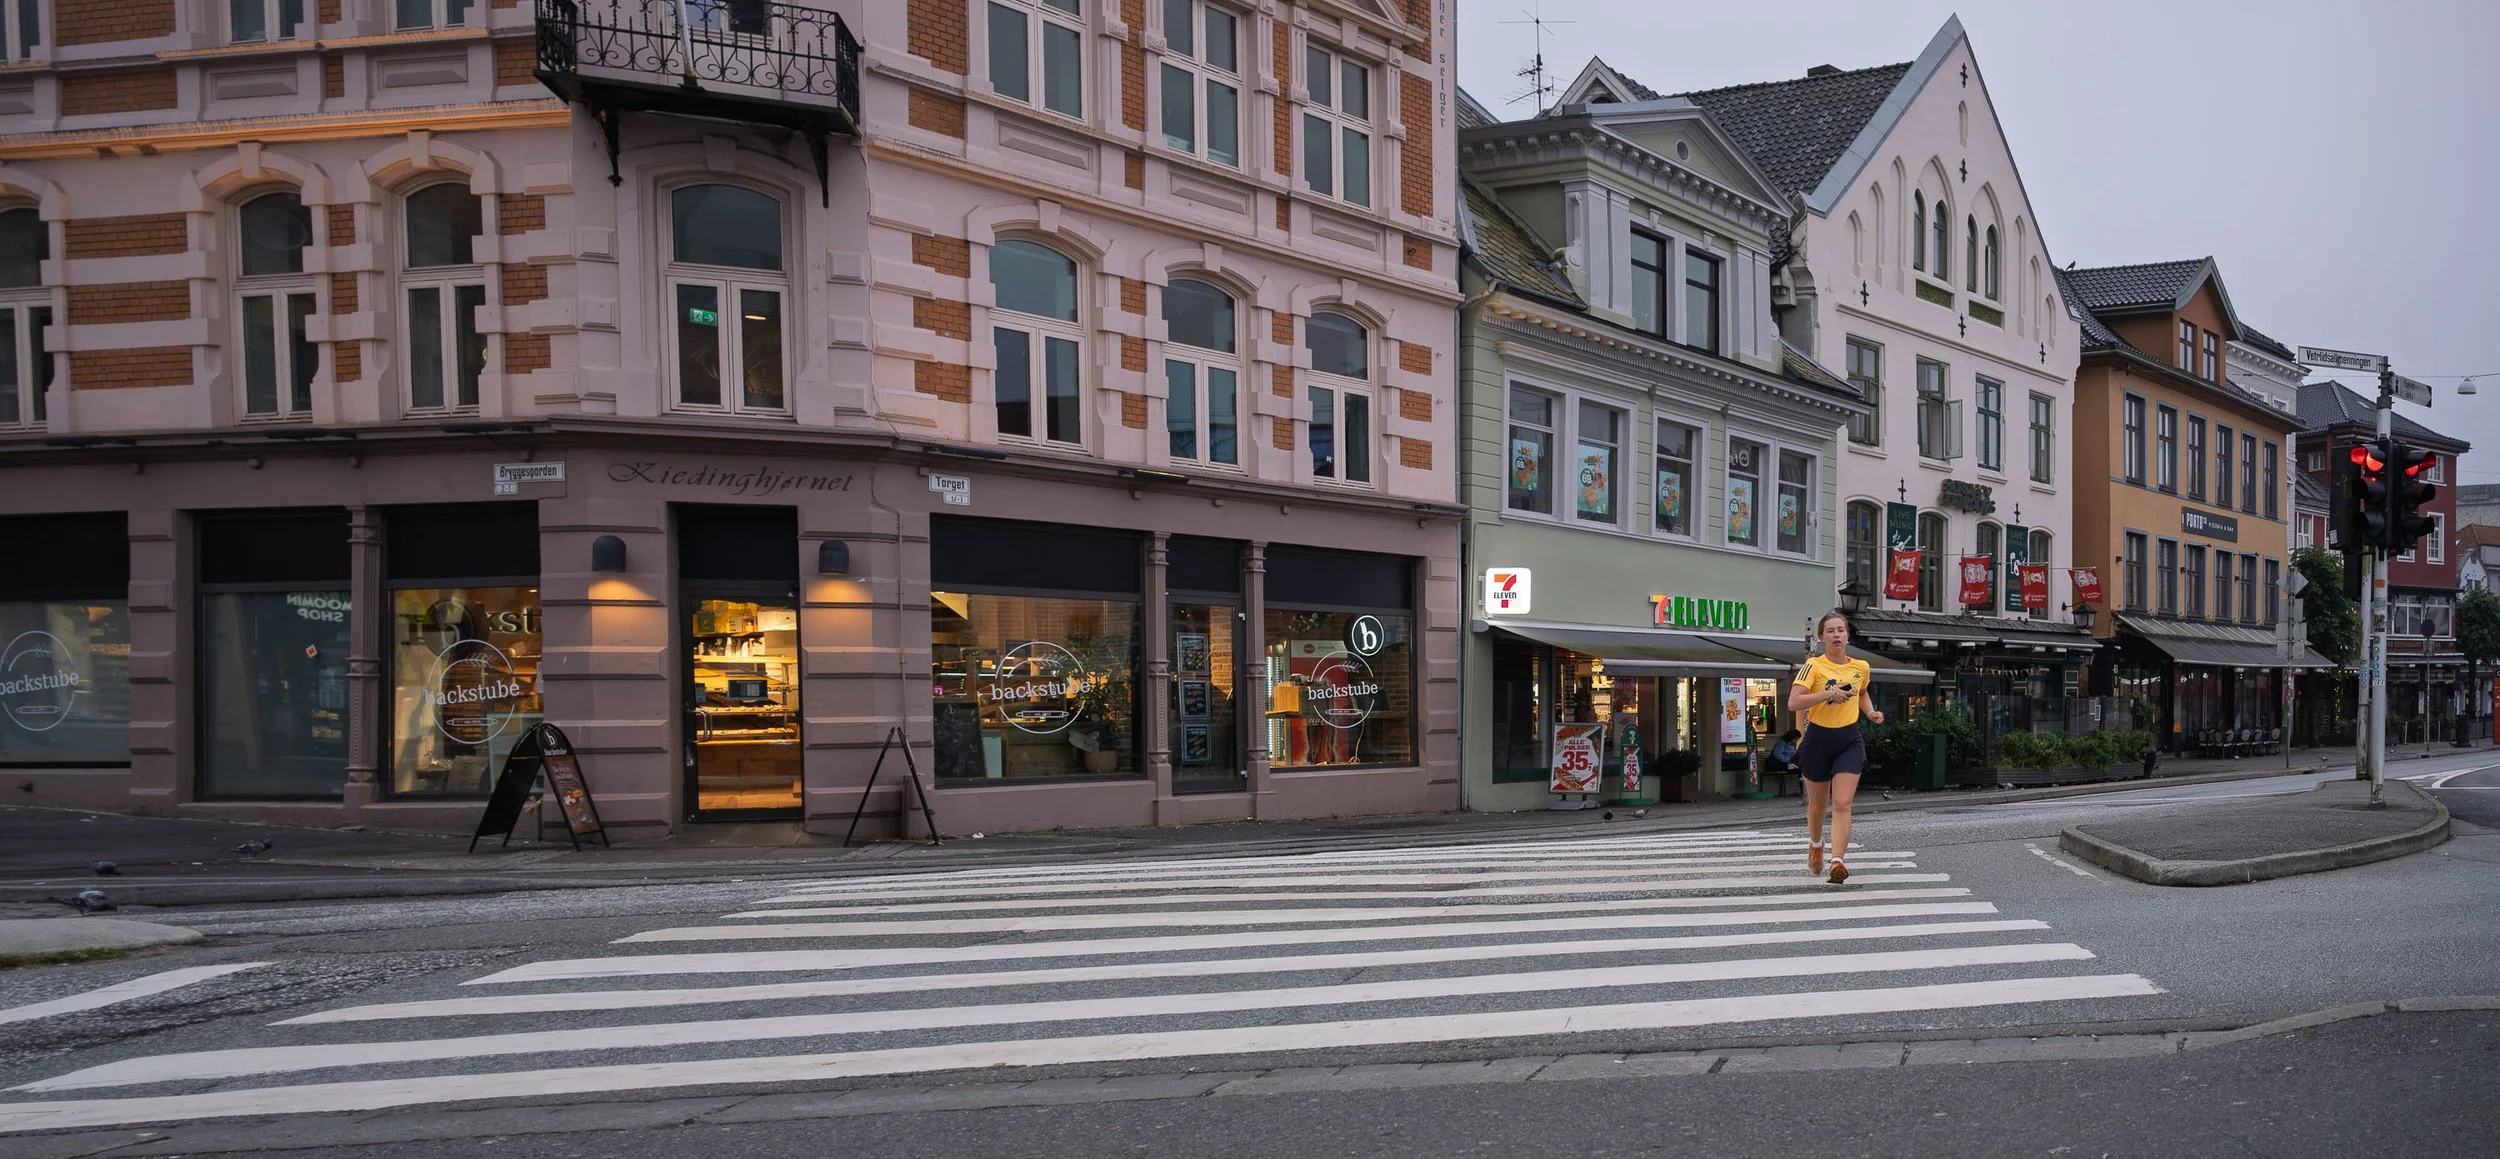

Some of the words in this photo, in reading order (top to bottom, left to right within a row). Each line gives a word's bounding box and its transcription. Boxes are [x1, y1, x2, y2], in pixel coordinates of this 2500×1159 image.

[500, 465, 557, 480] Bryggesporden
[935, 476, 965, 491] Torget
[1893, 511, 1910, 519] LIVE
[1889, 521, 1913, 530] MUSIC
[424, 680, 520, 706] backstube
[990, 679, 1091, 701] backstube
[1307, 681, 1378, 701] backstube
